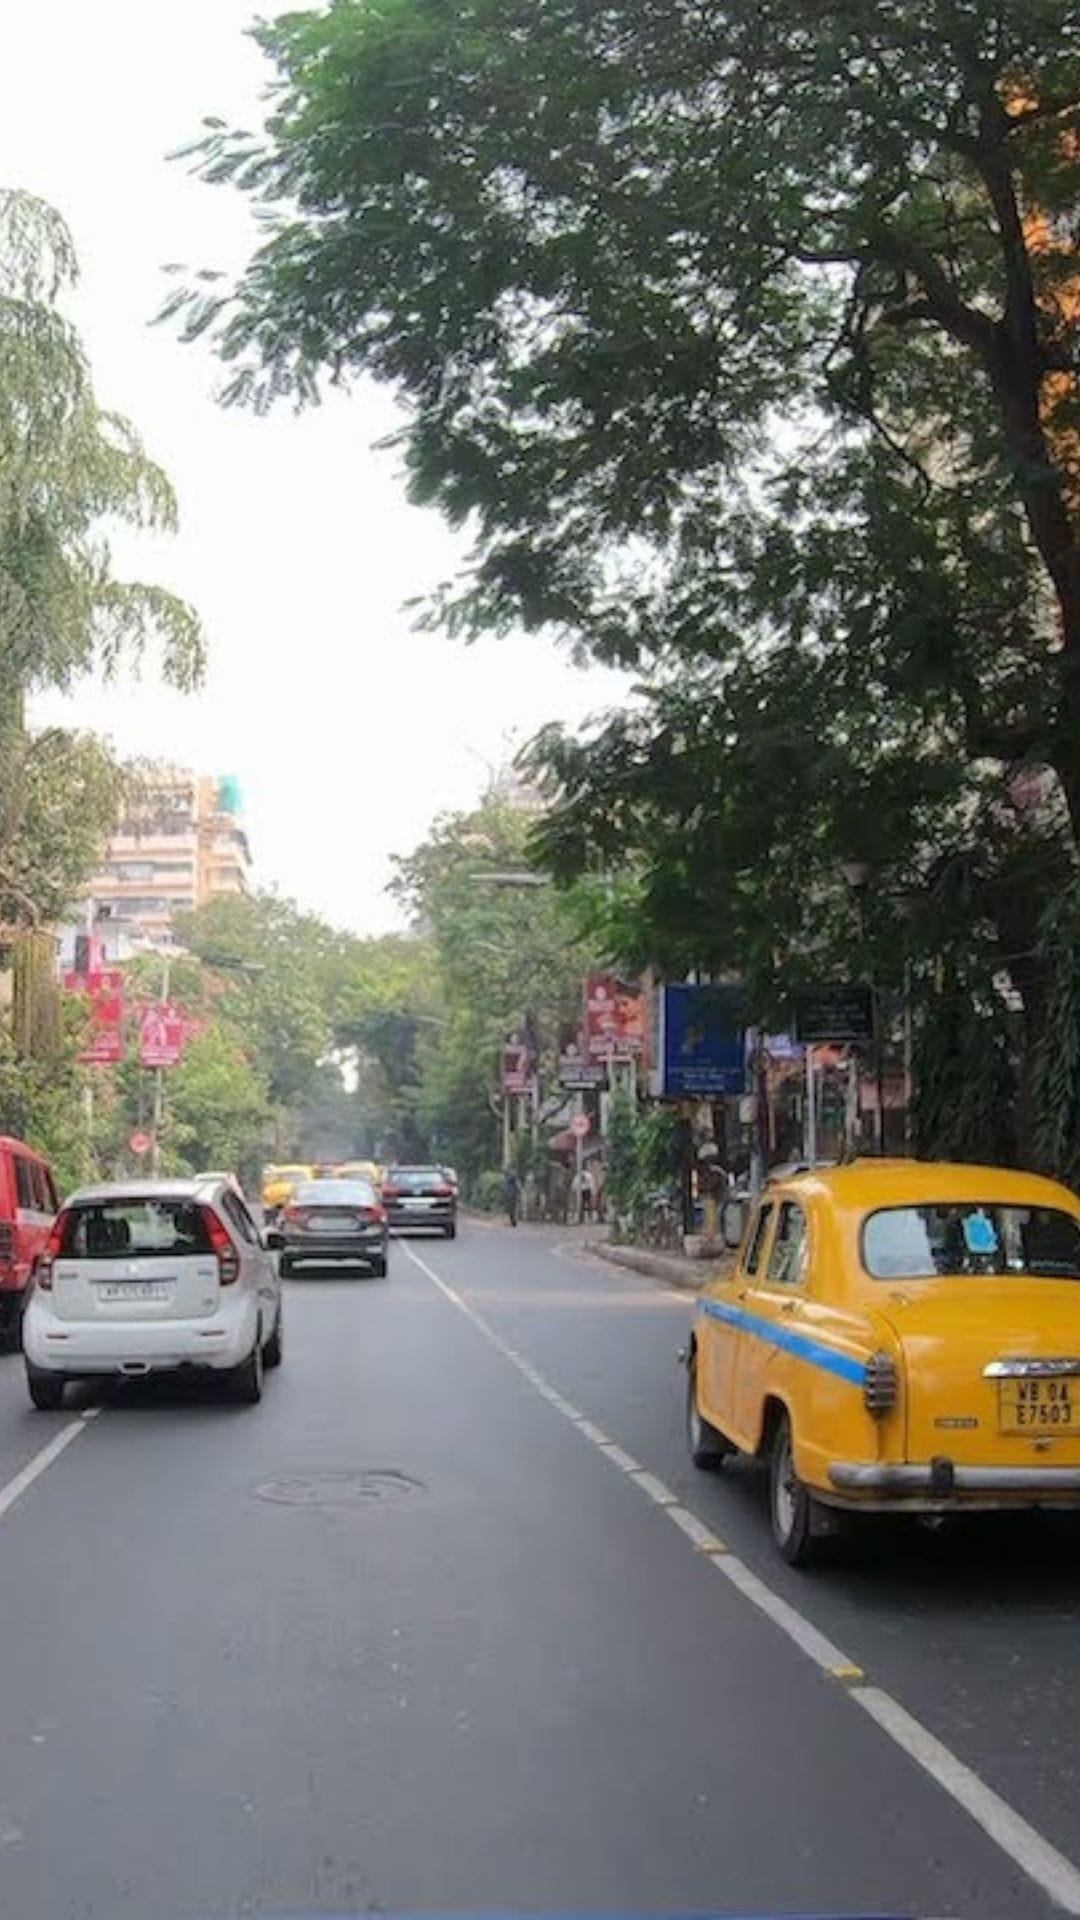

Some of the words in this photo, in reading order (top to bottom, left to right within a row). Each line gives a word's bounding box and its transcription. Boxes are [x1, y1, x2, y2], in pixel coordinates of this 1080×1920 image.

[1017, 1381, 1038, 1400] WB
[1048, 1381, 1068, 1401] 04
[1017, 1404, 1071, 1424] E7503
